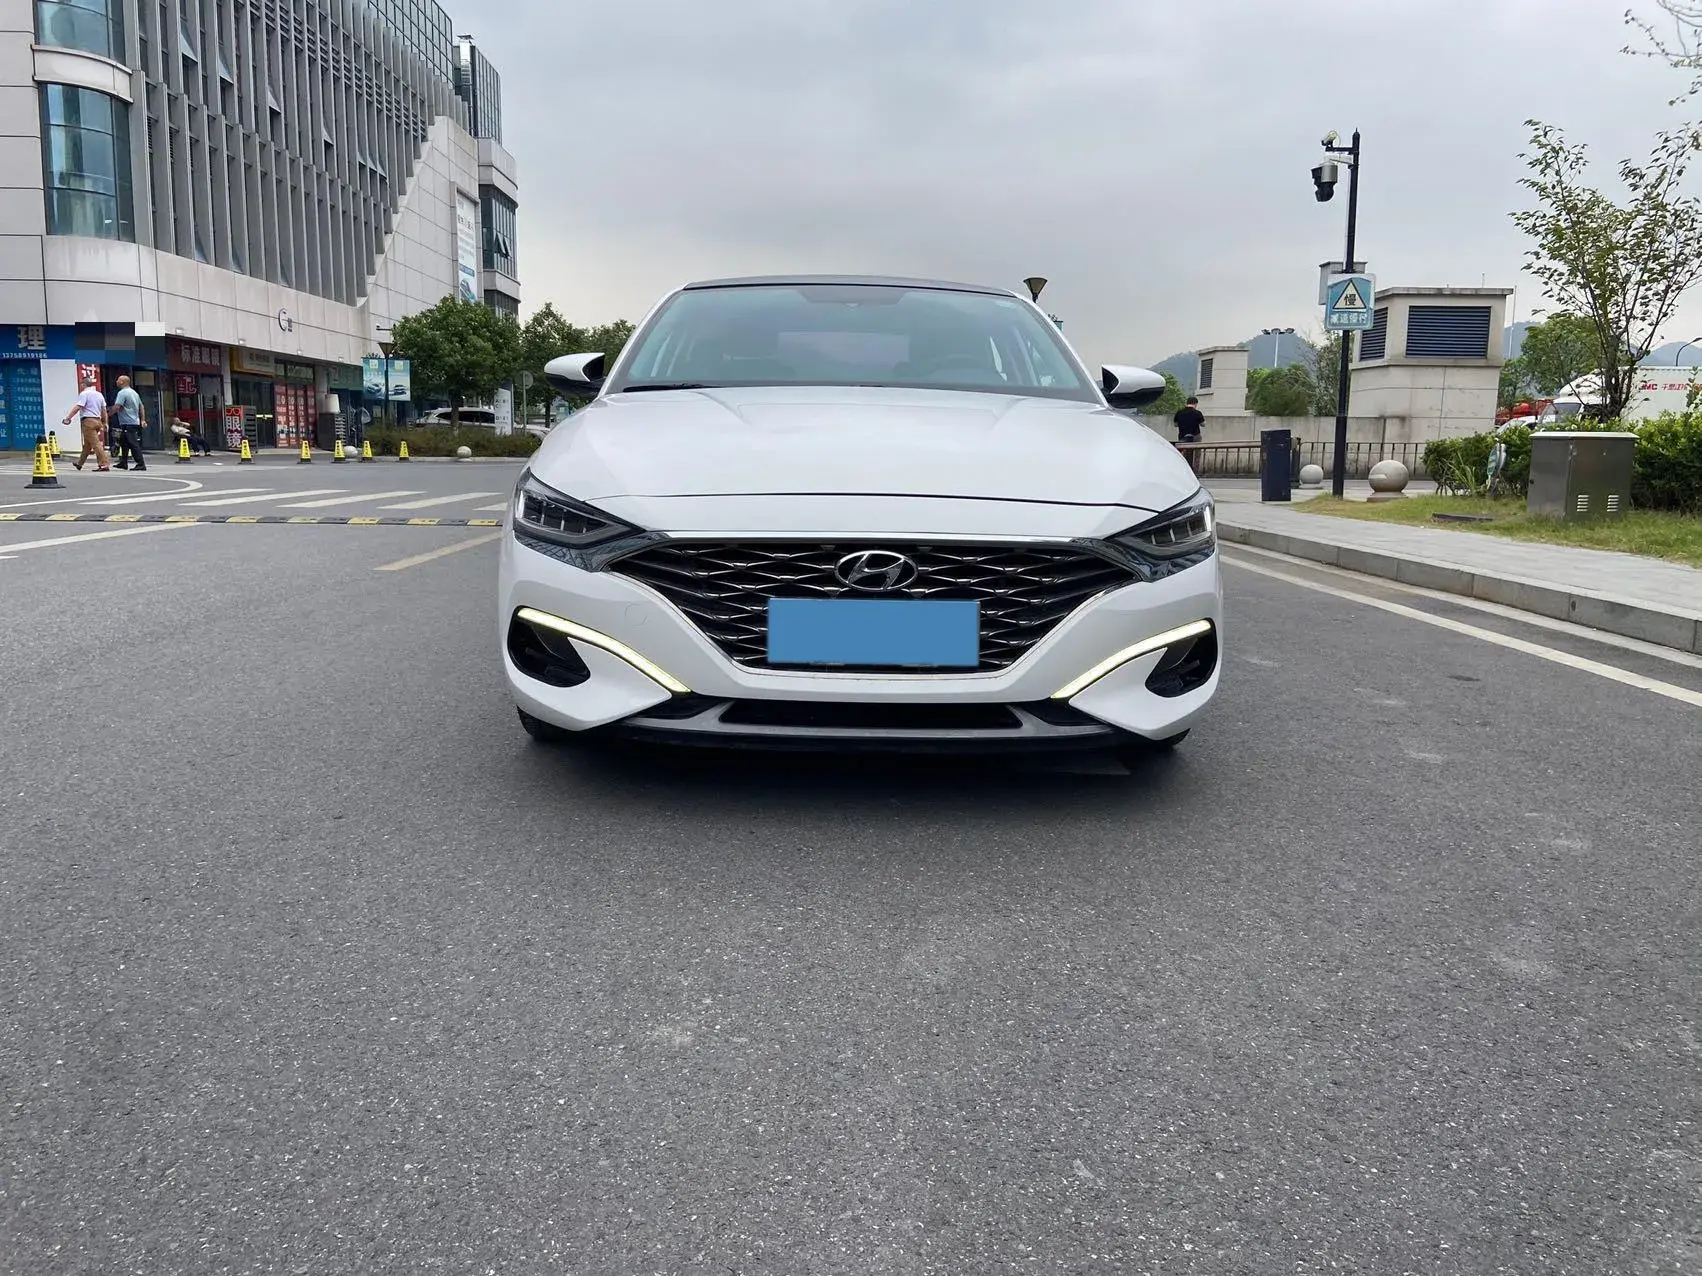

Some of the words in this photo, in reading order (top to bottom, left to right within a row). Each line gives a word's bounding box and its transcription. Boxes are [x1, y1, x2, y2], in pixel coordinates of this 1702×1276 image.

[17, 325, 46, 350] 理
[181, 344, 220, 366] 标准眼镜
[225, 415, 242, 448] 眼镜
